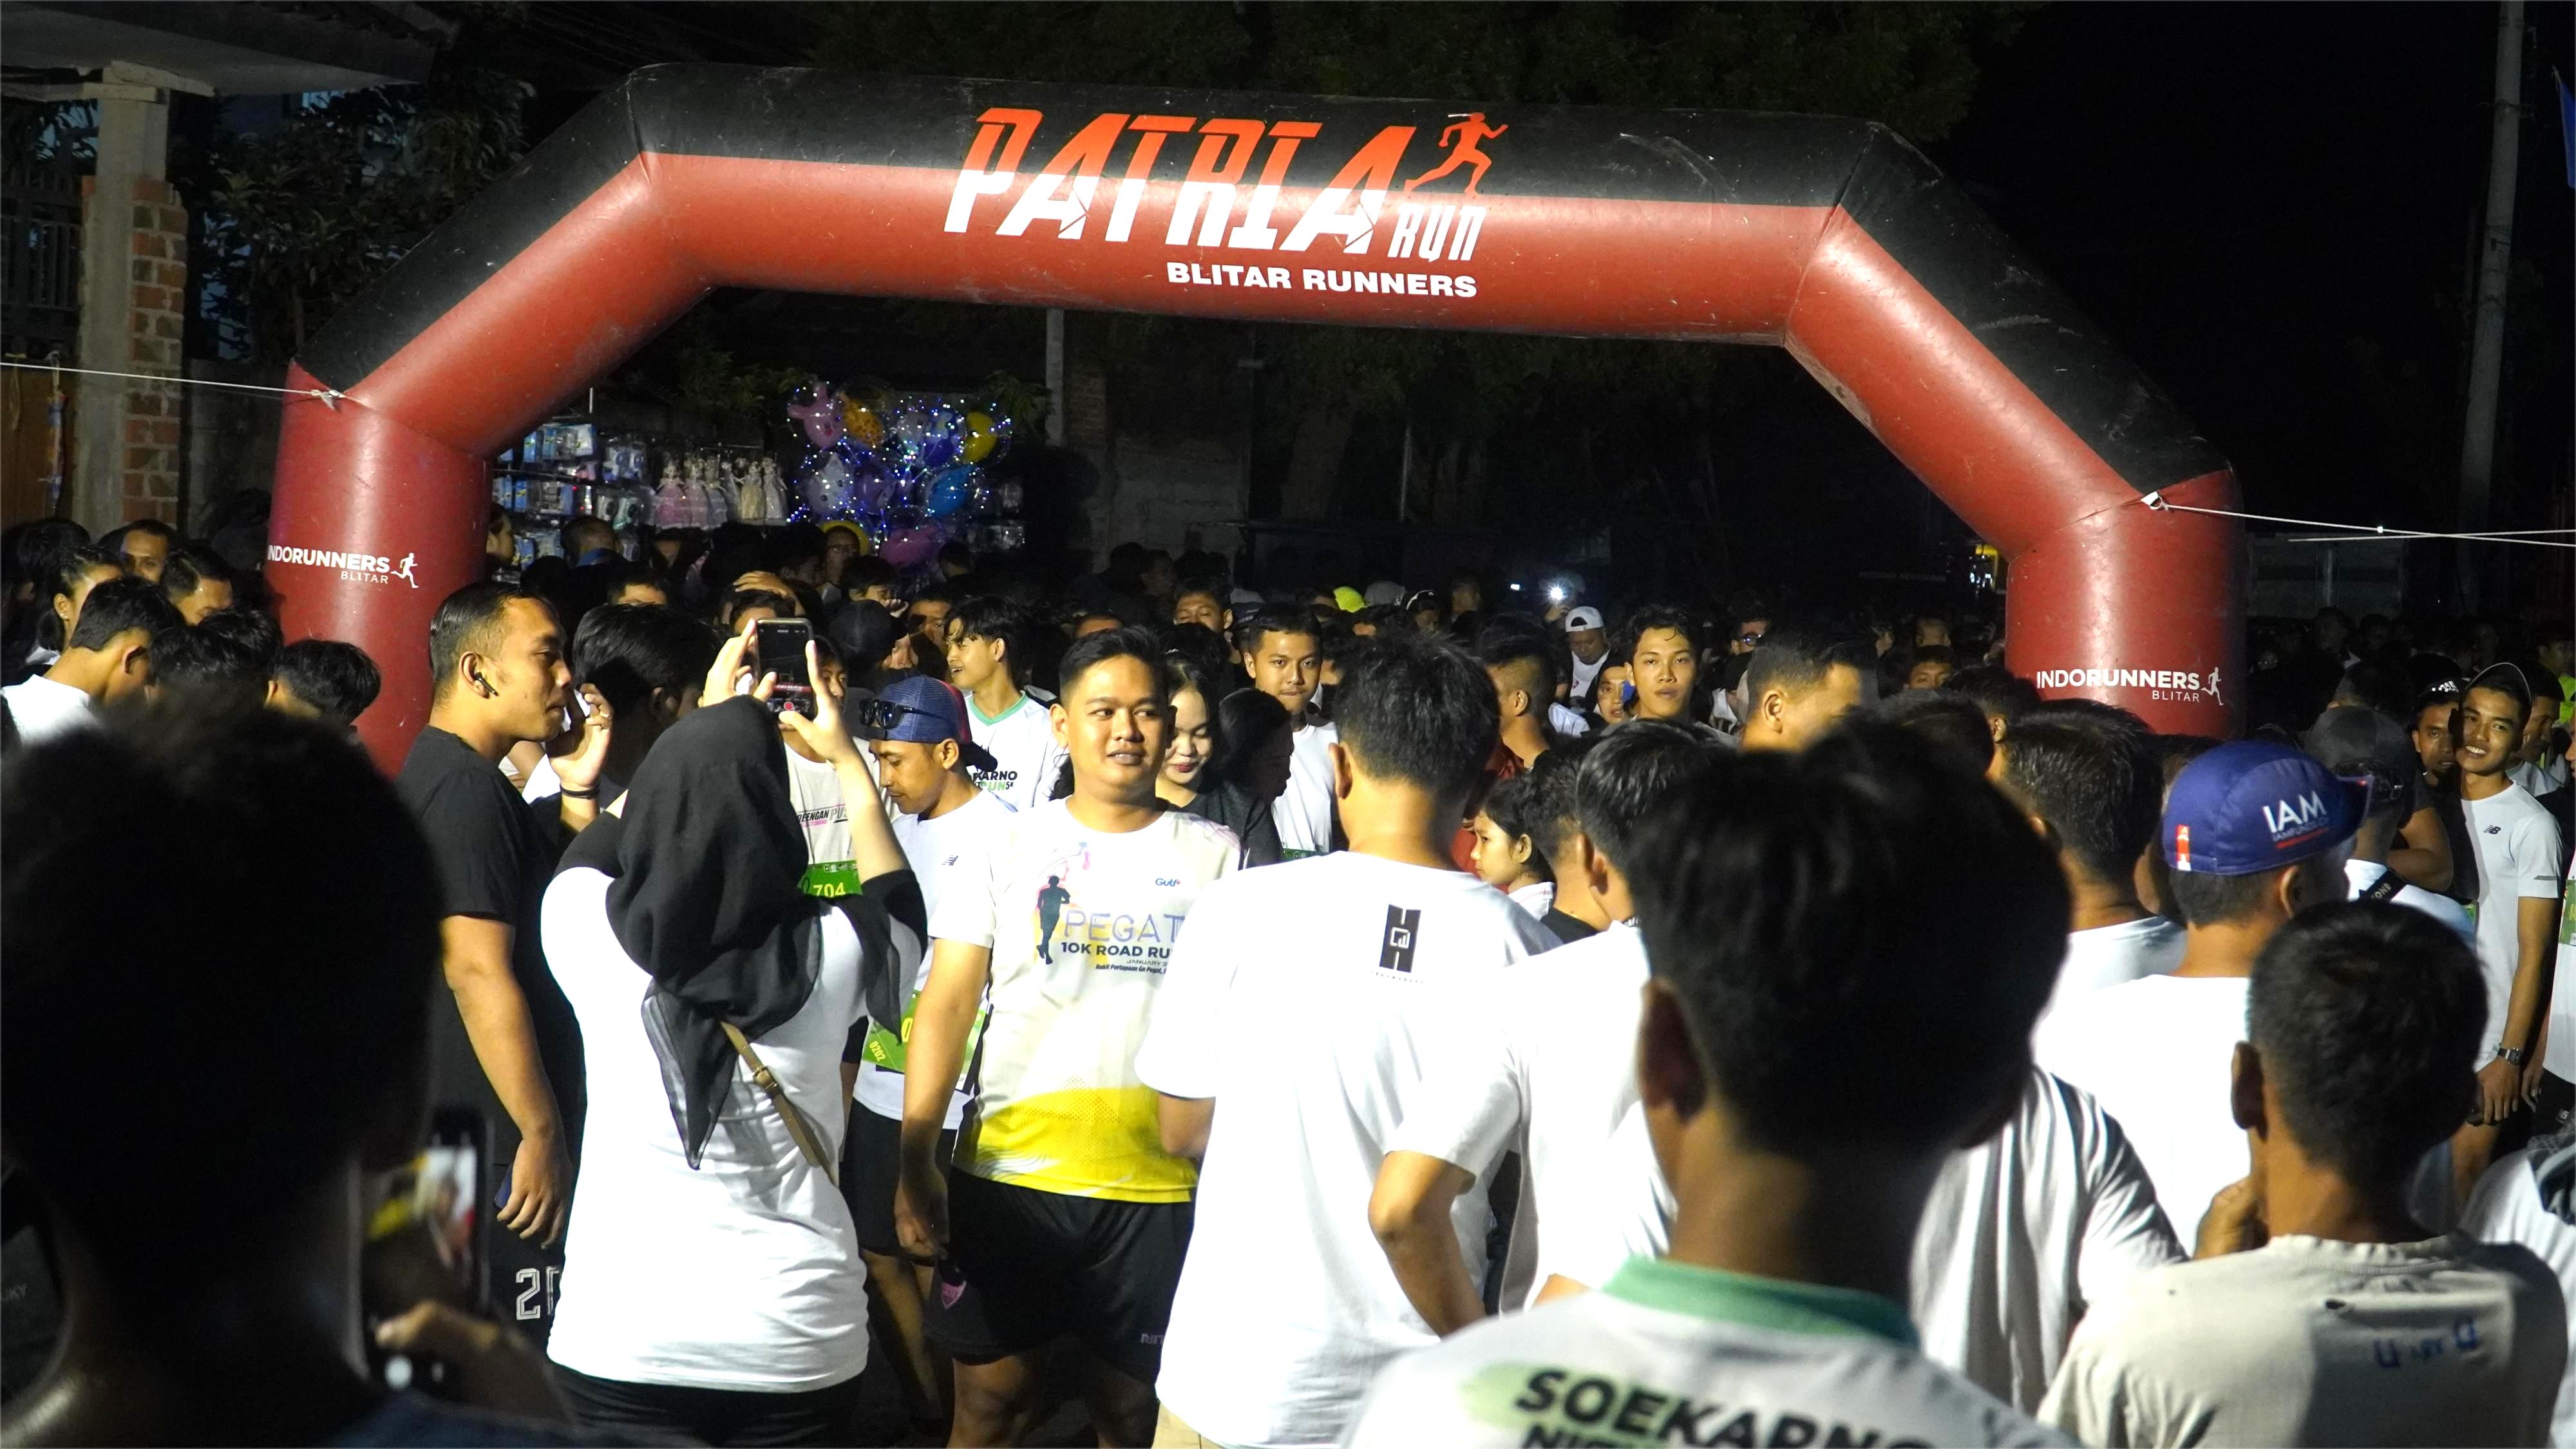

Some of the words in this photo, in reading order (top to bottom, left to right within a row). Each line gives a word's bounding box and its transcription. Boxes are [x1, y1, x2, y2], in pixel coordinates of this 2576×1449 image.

[943, 107, 1416, 254] PATRIA
[1166, 261, 1291, 289] BLITAR
[1303, 268, 1477, 298] RUNNERS
[267, 545, 390, 573] NDORUNNERS
[341, 571, 388, 584] BLITAR
[2037, 668, 2200, 690] INDORUNNERS
[2152, 690, 2199, 702] BLITAR
[2262, 790, 2327, 833] IAM
[813, 882, 846, 898] 704
[1061, 942, 1092, 954] 10K
[1096, 945, 1142, 957] ROAD
[1148, 947, 1172, 958] RU
